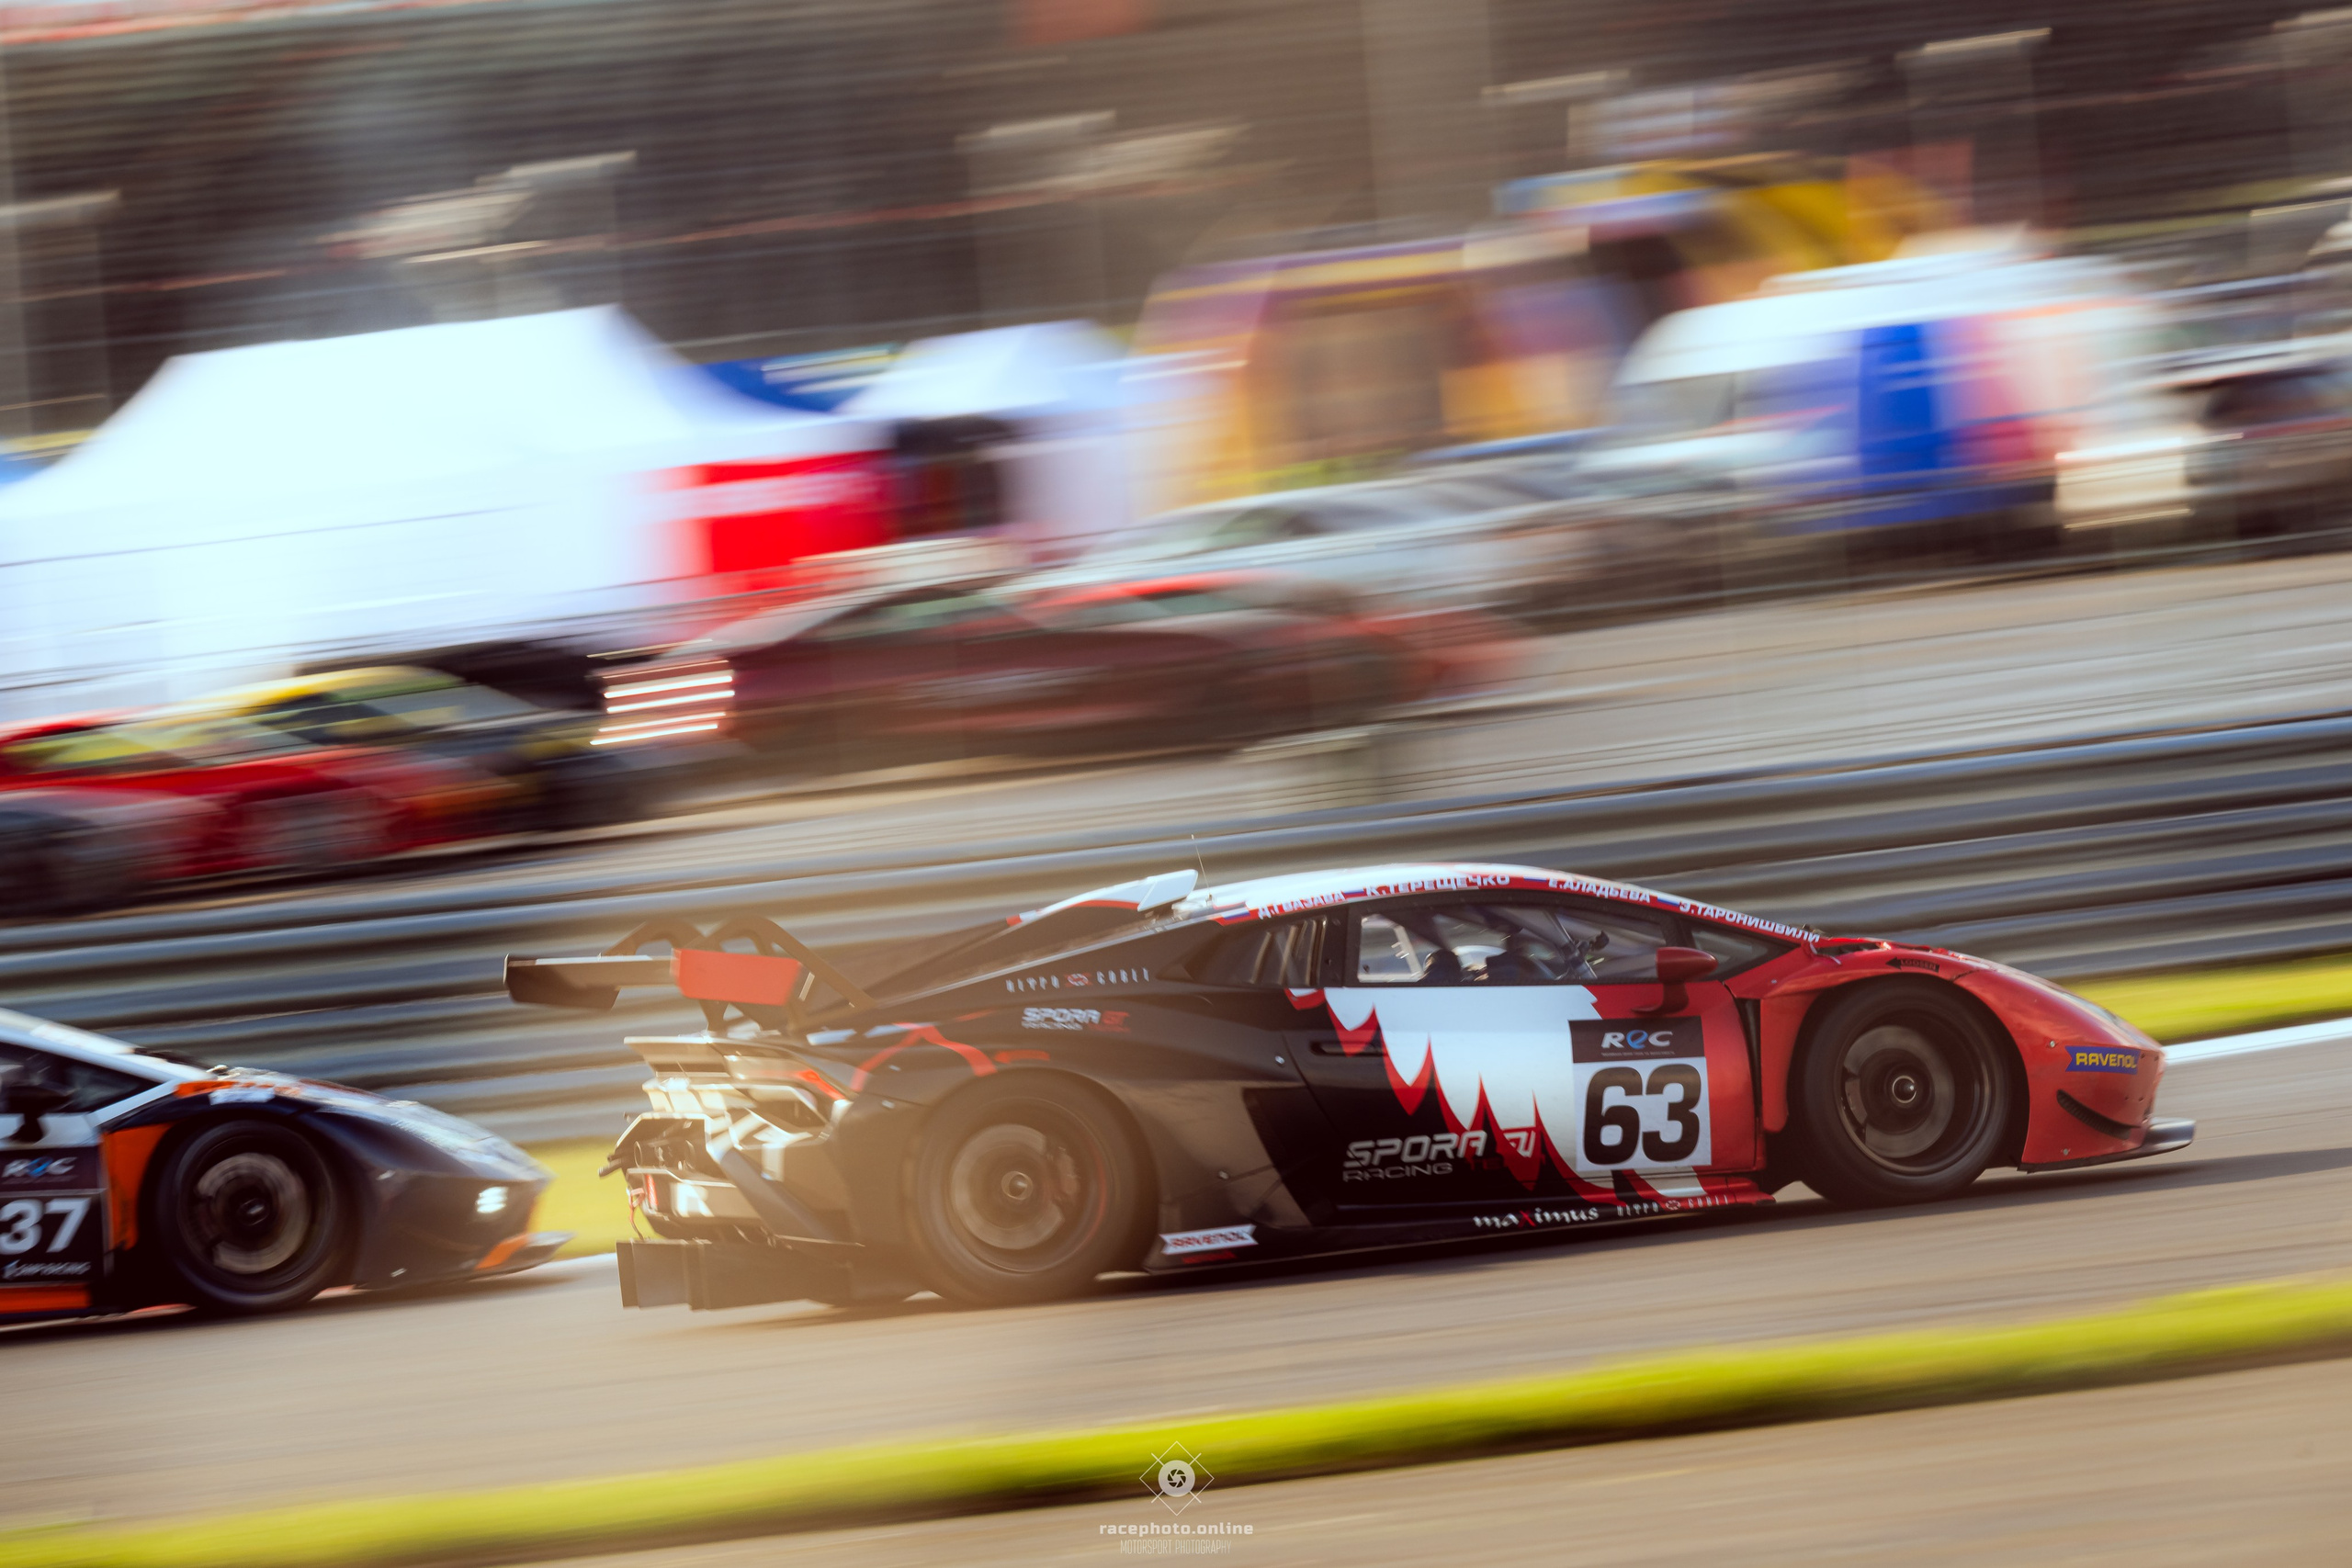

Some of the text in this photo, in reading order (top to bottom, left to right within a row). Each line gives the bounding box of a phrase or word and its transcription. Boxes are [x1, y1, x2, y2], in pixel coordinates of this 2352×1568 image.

[1679, 900, 1821, 943] Э.ТАРОНИШВИЛИ
[1022, 1007, 1102, 1024] SPORA
[2076, 1052, 2137, 1068] RAVENOL
[1584, 1063, 1702, 1166] 63
[1343, 1130, 1487, 1168] SPORA
[1342, 1161, 1453, 1183] RACING
[0, 1198, 91, 1256] 37
